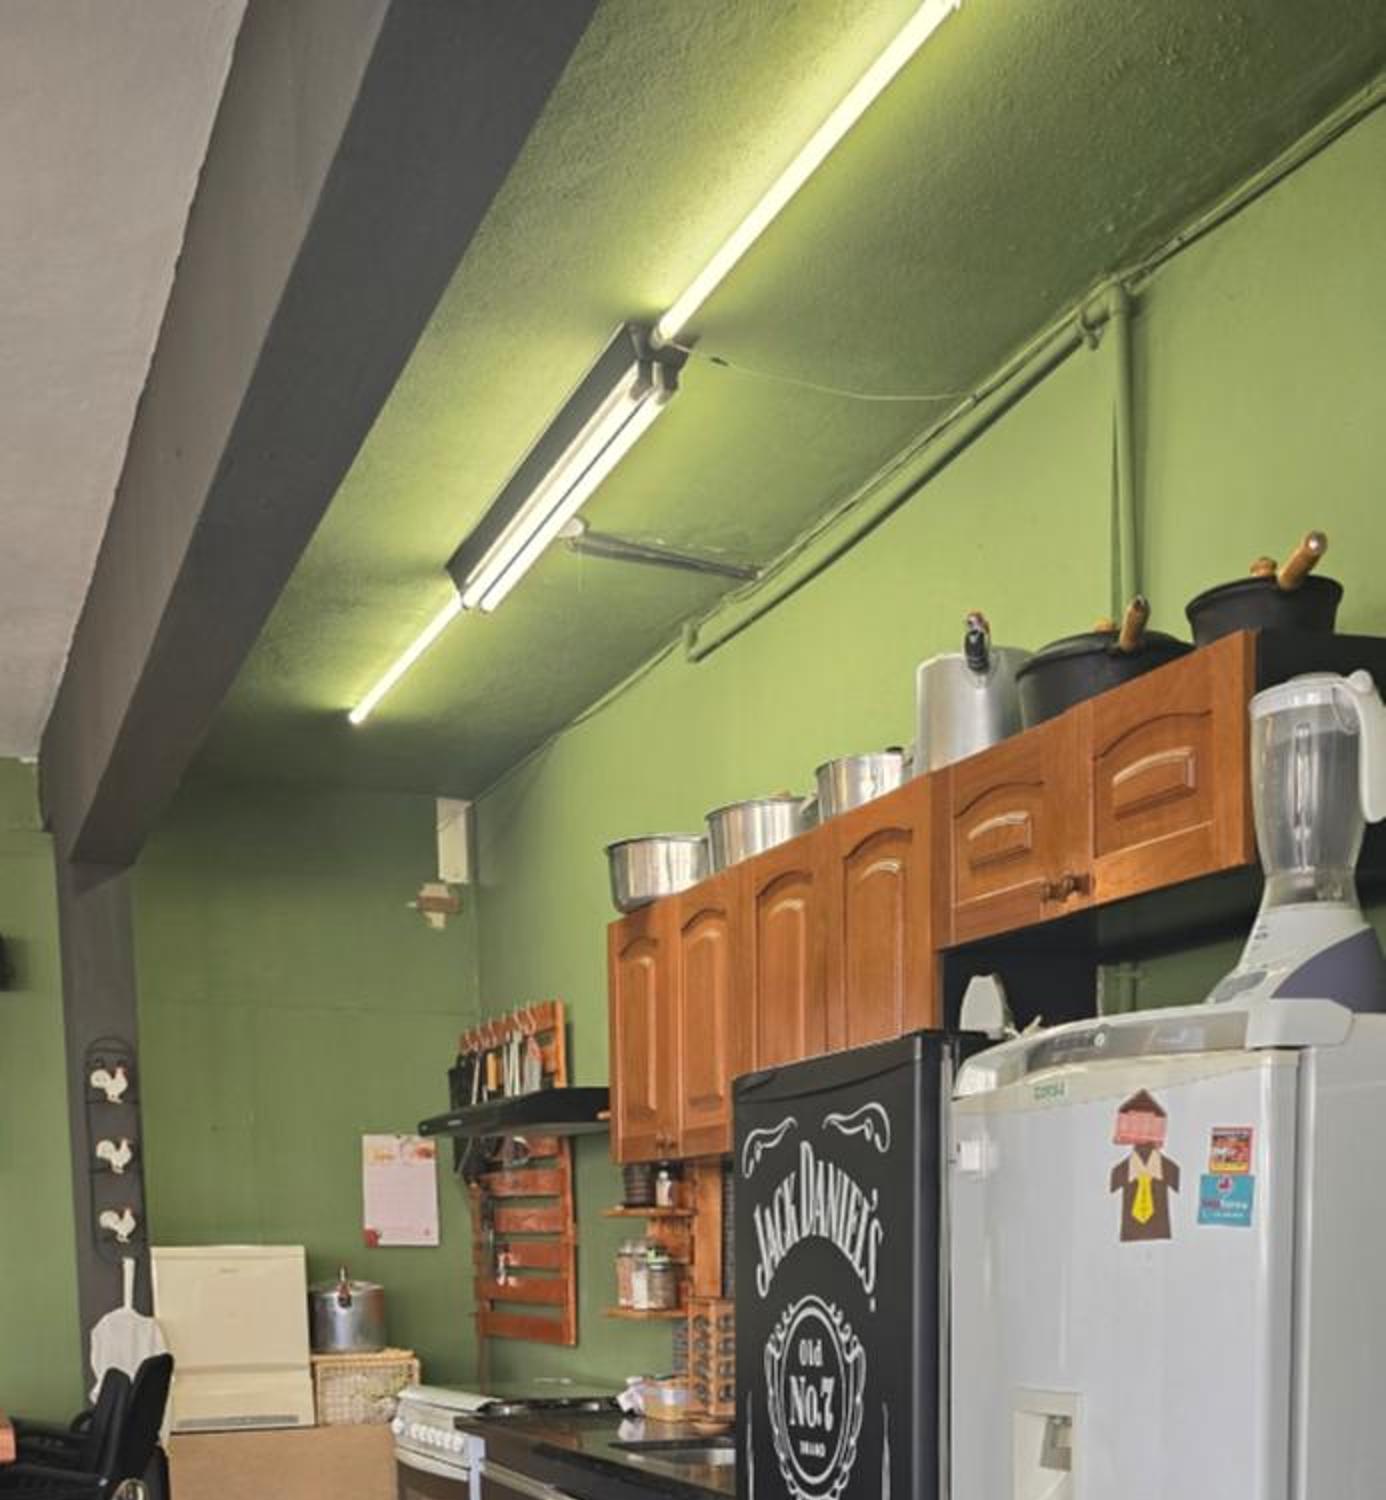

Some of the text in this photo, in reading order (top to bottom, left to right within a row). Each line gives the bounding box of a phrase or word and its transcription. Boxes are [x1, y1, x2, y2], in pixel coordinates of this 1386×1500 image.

[753, 1140, 884, 1298] JACK DANIEL'S
[798, 1338, 824, 1367] Old
